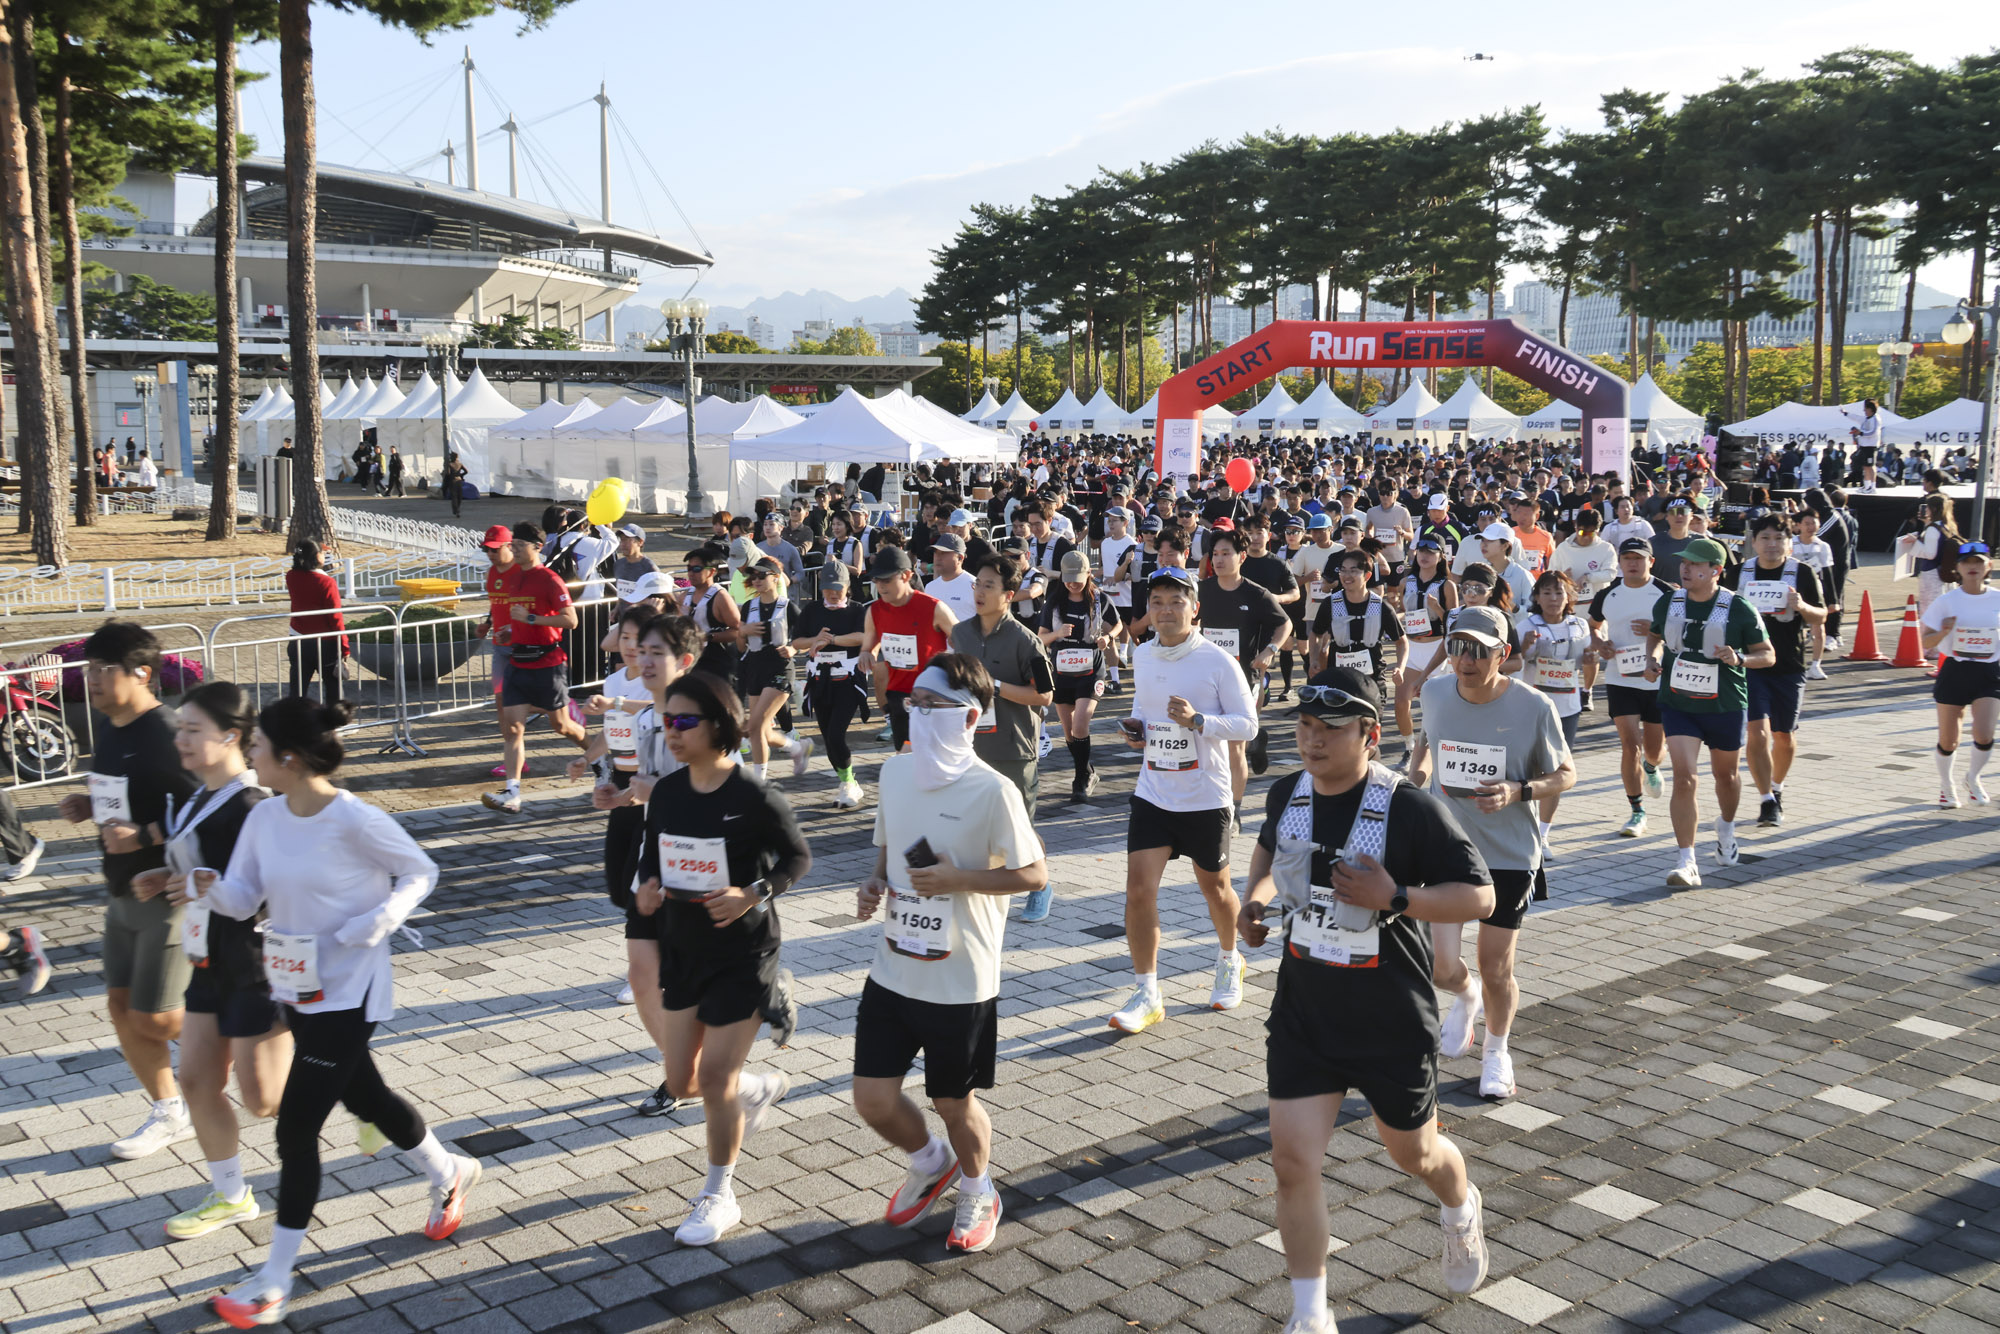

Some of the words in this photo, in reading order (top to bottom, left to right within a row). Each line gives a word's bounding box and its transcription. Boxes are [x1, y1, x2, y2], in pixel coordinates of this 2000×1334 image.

[1310, 331, 1376, 360] Run
[1196, 341, 1272, 396] START
[1515, 339, 1598, 395] FINISH
[1926, 432, 1950, 443] MC
[1408, 618, 1425, 626] 2364
[892, 646, 912, 655] 1414
[1548, 670, 1572, 678] 6286
[1685, 674, 1712, 683] 1771
[1159, 739, 1188, 749] 1629
[1446, 761, 1456, 770] M
[1460, 761, 1497, 776] 1349
[679, 859, 718, 873] 2586
[901, 912, 942, 931] 1503
[1302, 911, 1311, 922] M
